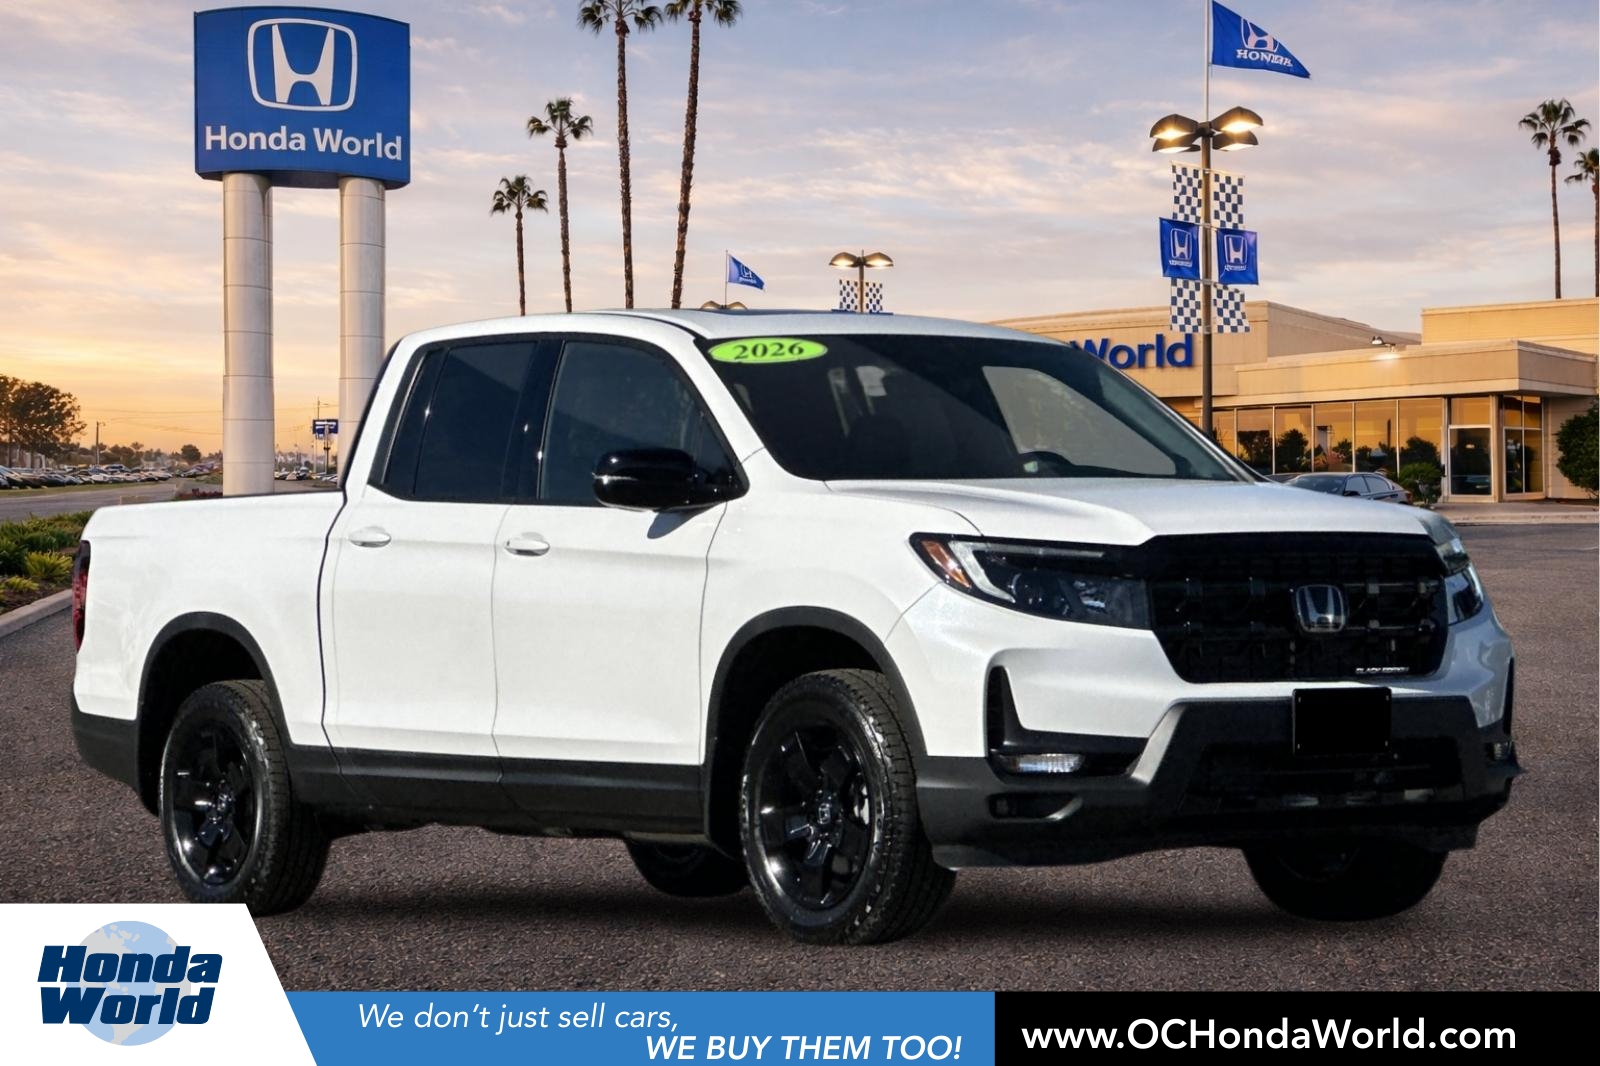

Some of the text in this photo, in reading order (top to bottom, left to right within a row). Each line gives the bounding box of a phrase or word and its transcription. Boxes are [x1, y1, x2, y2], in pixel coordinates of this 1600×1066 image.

[205, 125, 402, 161] Honda World
[733, 342, 804, 360] 2026
